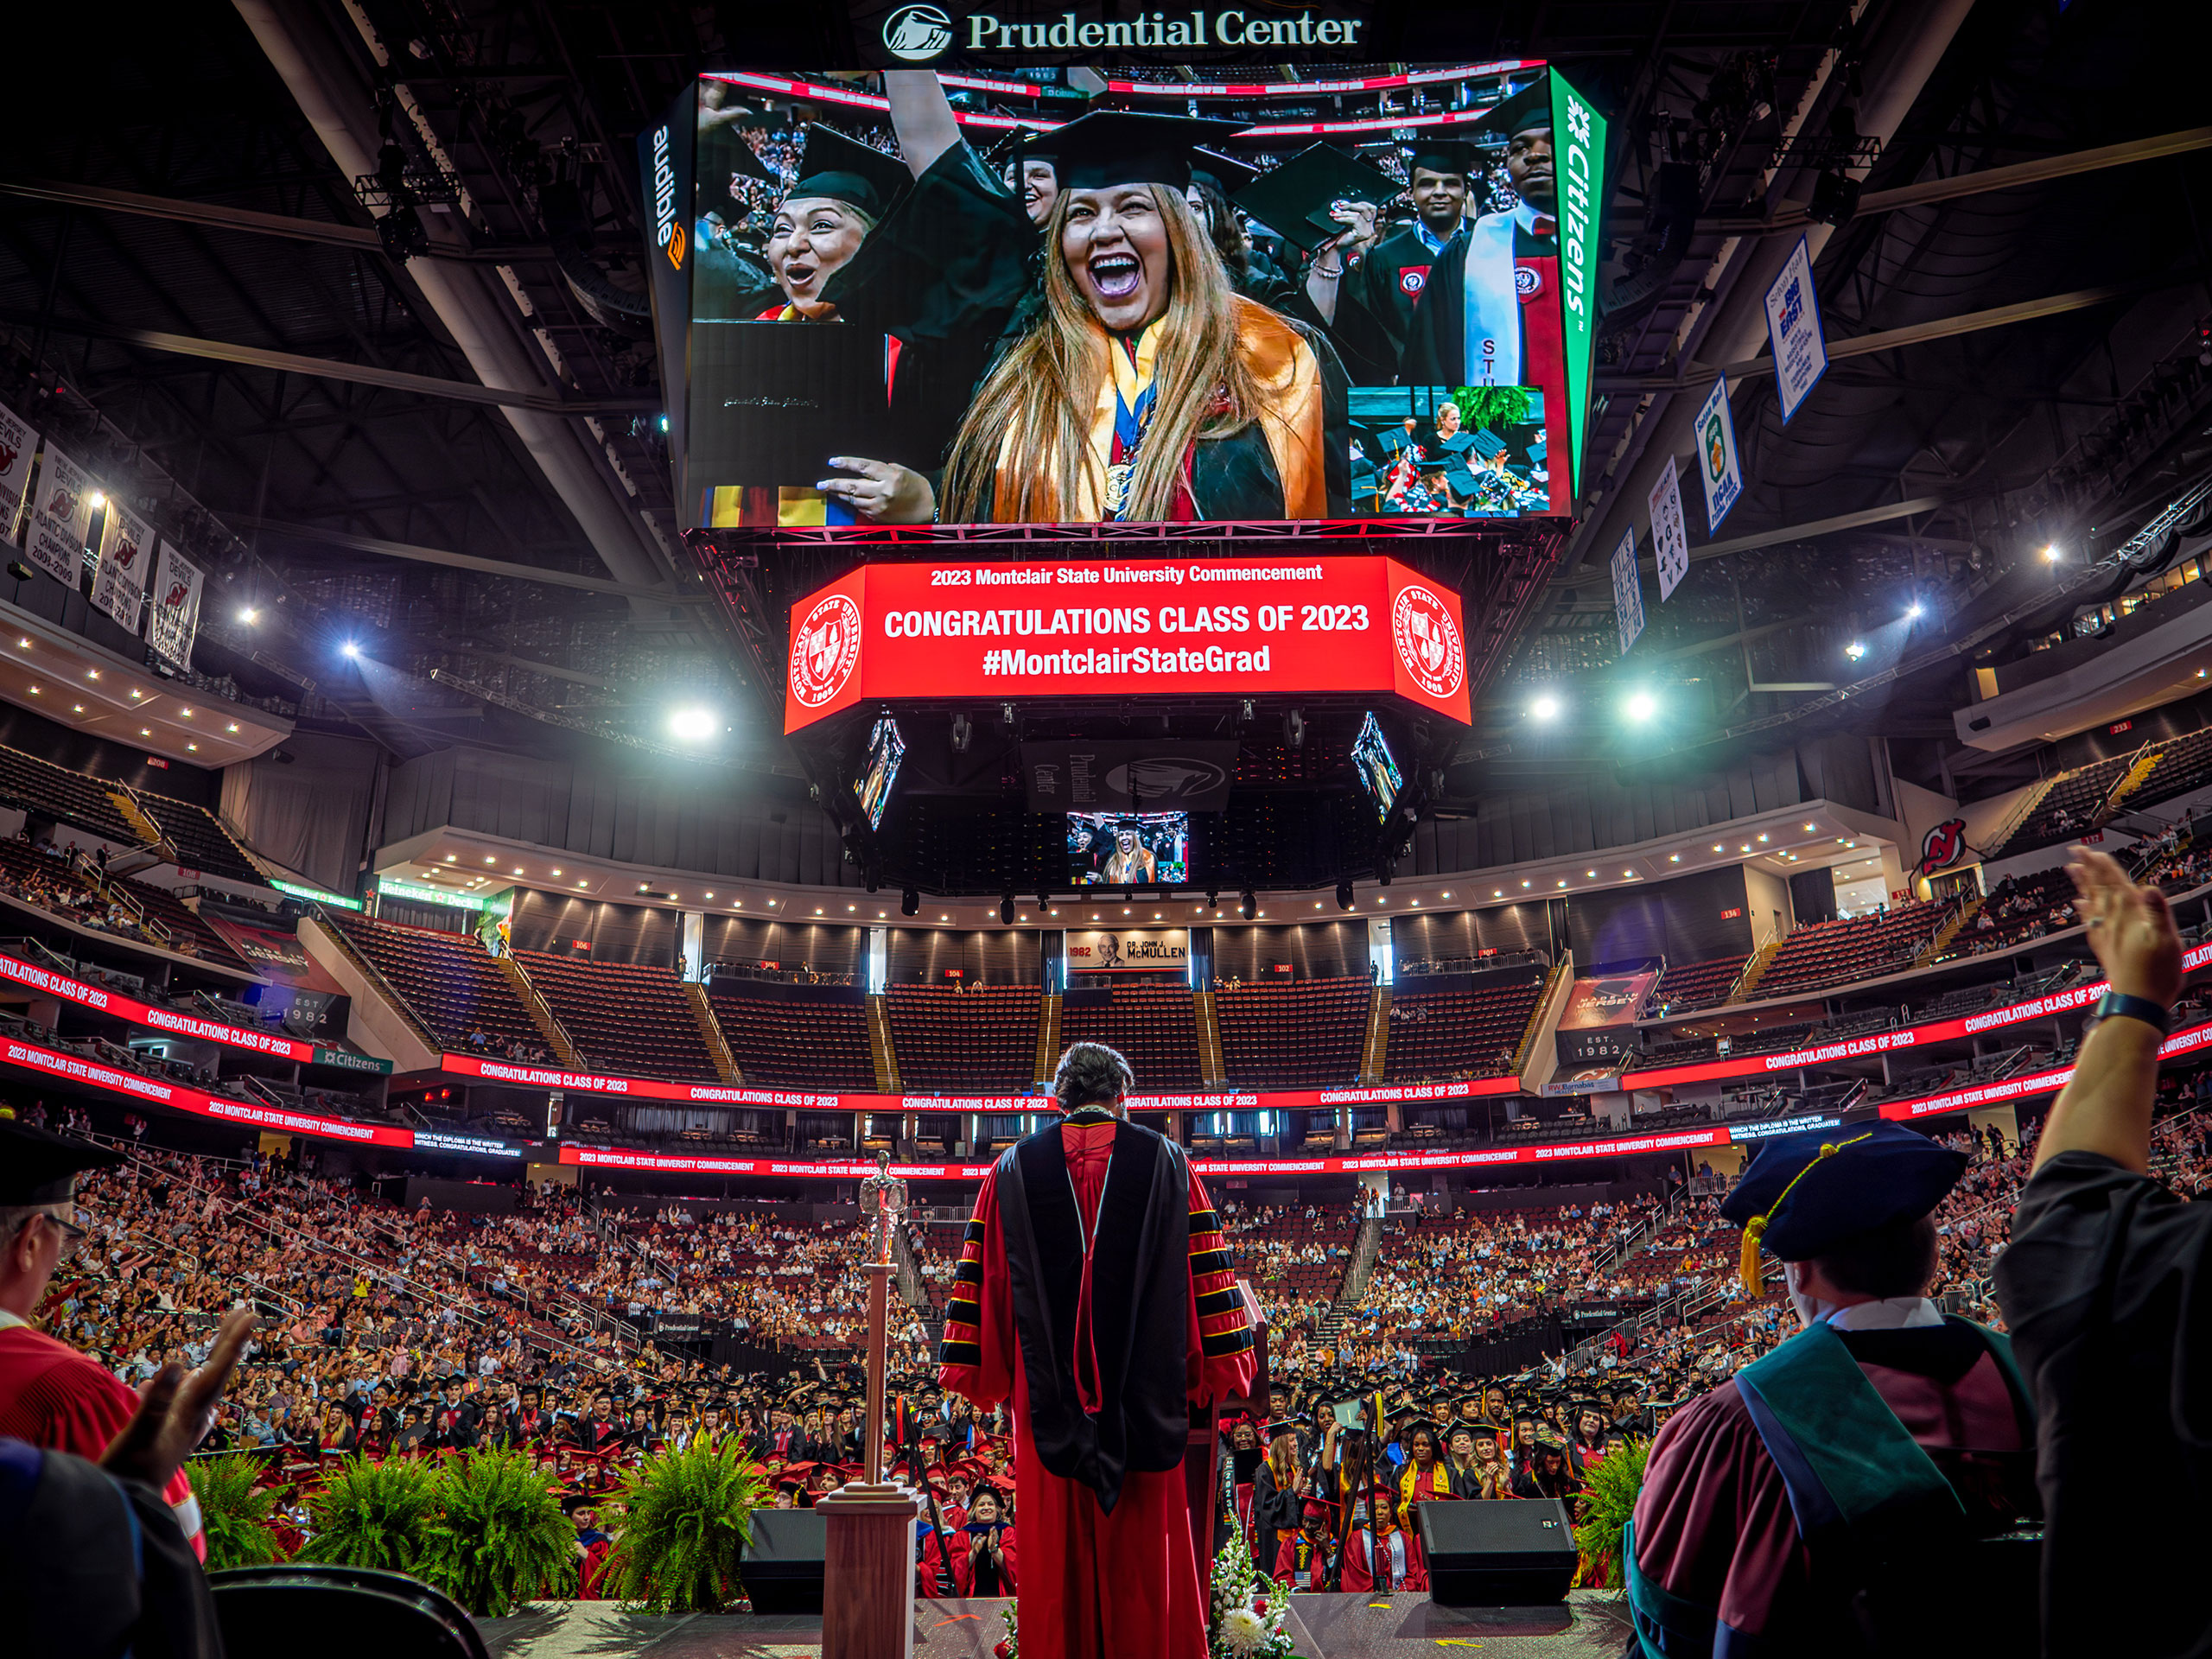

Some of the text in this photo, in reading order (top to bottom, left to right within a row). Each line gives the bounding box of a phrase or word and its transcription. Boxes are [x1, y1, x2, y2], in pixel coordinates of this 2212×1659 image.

[966, 10, 1362, 49] Prudential Center
[653, 125, 677, 247] audible
[1567, 143, 1589, 317] Citizens
[931, 564, 1323, 586] 2023 Montclair State University Commencement
[812, 600, 840, 621] STATE
[1410, 590, 1439, 610] STATE
[884, 605, 1370, 638] CONGRATULATIONS CLASS OF 2023
[982, 645, 1270, 675] #MontclairStateGrad
[1034, 765, 1061, 794] Center
[1070, 754, 1096, 802] Prudential
[282, 884, 346, 906] Heineken Deck
[380, 882, 474, 909] Heineken Deck
[575, 941, 587, 950] 106
[1069, 947, 1091, 957] 1982
[1128, 947, 1185, 958] McMULLEN
[49, 974, 107, 1008] CLASS OF 2023
[295, 998, 323, 1008] EST.
[1577, 997, 1637, 1008] JERSEY
[1965, 1001, 2043, 1033] CONGRATULATIONS
[2044, 994, 2073, 1012] CLASS
[2075, 989, 2087, 1004] OF
[283, 1007, 327, 1024] 1982
[148, 1009, 290, 1055] CONGRATULATIONS CLASS OF 2023
[1578, 1046, 1620, 1057] 1982
[1765, 1031, 1915, 1069] CONGRATULATIONS CLASS OF 2023
[8, 1045, 171, 1100] 2023 MONTCLAIR STATE UNIVERSITY COMMENCEMENT
[336, 1053, 380, 1071] Citizens
[480, 1063, 627, 1092] CONGRATULATIONS CLASS OF 2023
[690, 1087, 838, 1107] CONGRATULATIONS CLASS OF 2023
[902, 1097, 1048, 1109] CONGRATULATIONS CLASS OF 2023
[1193, 1095, 1257, 1106] CLASS OF 2023
[1320, 1084, 1469, 1103] CONGRATULATIONS CLASS OF 2023
[1911, 1082, 2022, 1114] 2023 MONTCLAIR STATE UNIVERSITY
[208, 1101, 224, 1114] 2023
[225, 1104, 263, 1121] MONTCLAIR
[264, 1112, 283, 1124] STATE
[284, 1116, 321, 1132] UNIVERSITY
[321, 1122, 373, 1139] COMMENCEMENT
[1535, 1133, 1713, 1158] 2023 MONTCLAIR STATE UNIVERSITY COMMENCEMENT
[579, 1153, 754, 1171] 2023 MONTCLAIR STATE UNIVERSITY COMMENCEMENT
[772, 1164, 944, 1176] 2023 MONTCLAIR STATE COMMENCEMENT
[1230, 1162, 1268, 1172] UNIVERSITY
[1268, 1161, 1325, 1172] COMMENCEMENT
[1342, 1160, 1358, 1169] 2023
[1359, 1158, 1399, 1168] MONTCLAIR
[1400, 1157, 1421, 1166] STATE
[1421, 1155, 1460, 1166] UNIVERSITY
[1461, 1151, 1517, 1163] COMMENCEMENT
